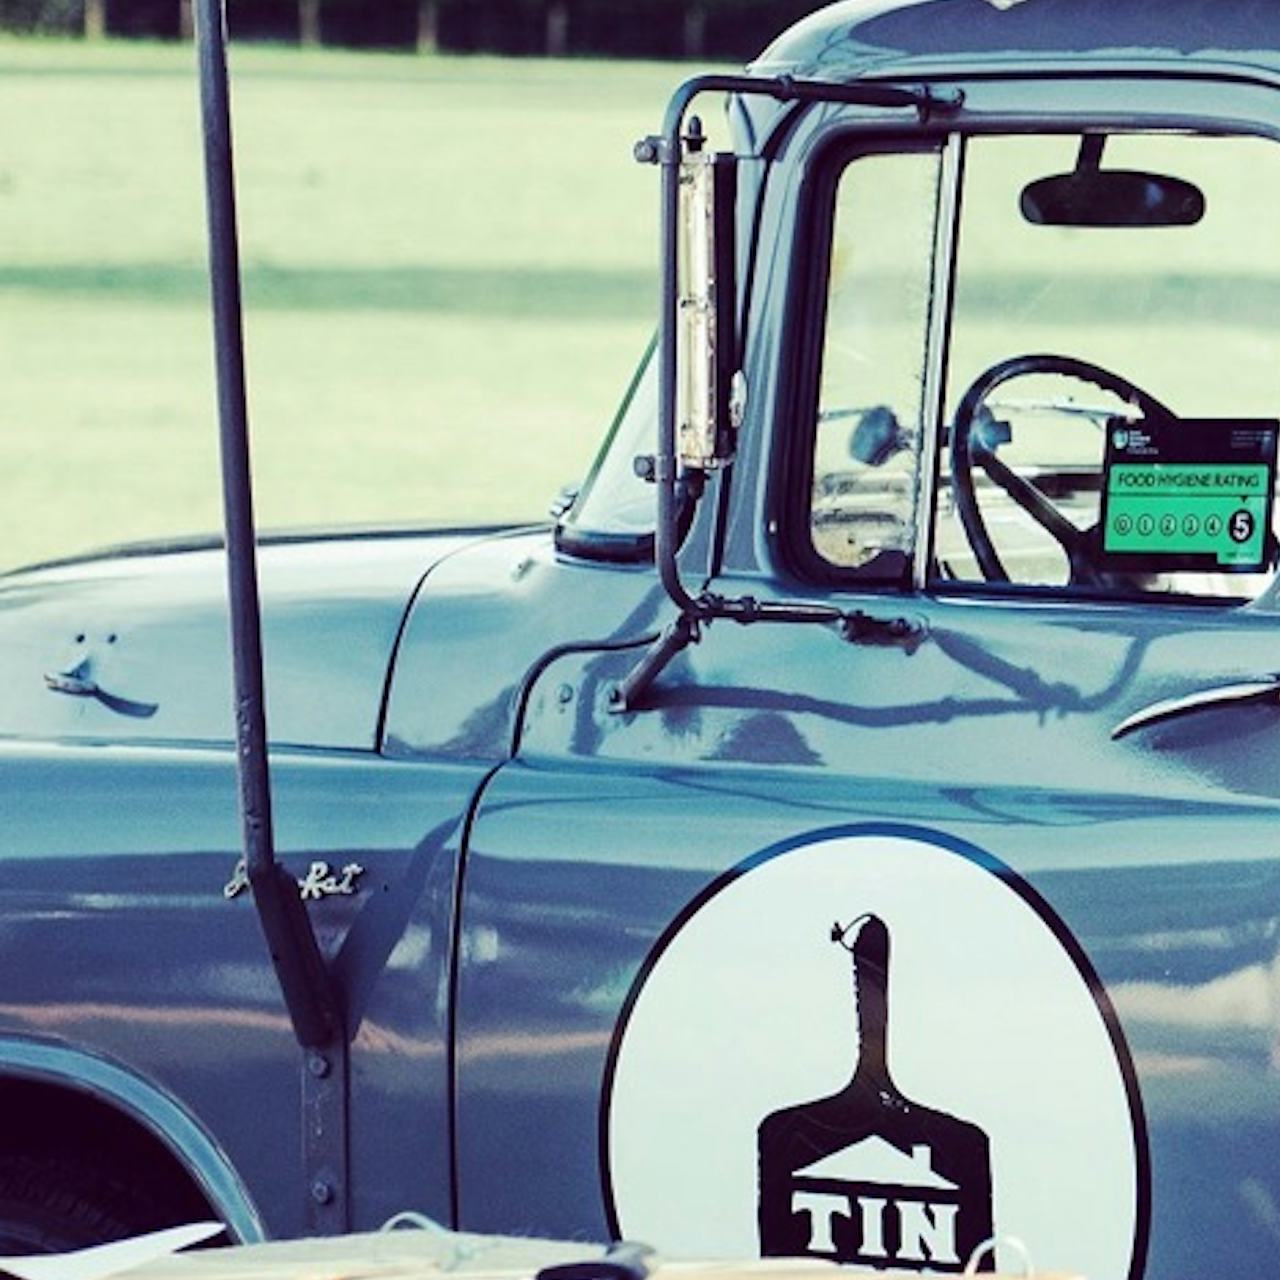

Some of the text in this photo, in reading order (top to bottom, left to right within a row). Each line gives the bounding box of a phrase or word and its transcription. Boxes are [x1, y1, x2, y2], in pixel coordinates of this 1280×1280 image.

[1119, 473, 1260, 487] FOOD HYGIENE RATING
[1232, 513, 1250, 540] 5
[792, 1191, 960, 1262] TIN
